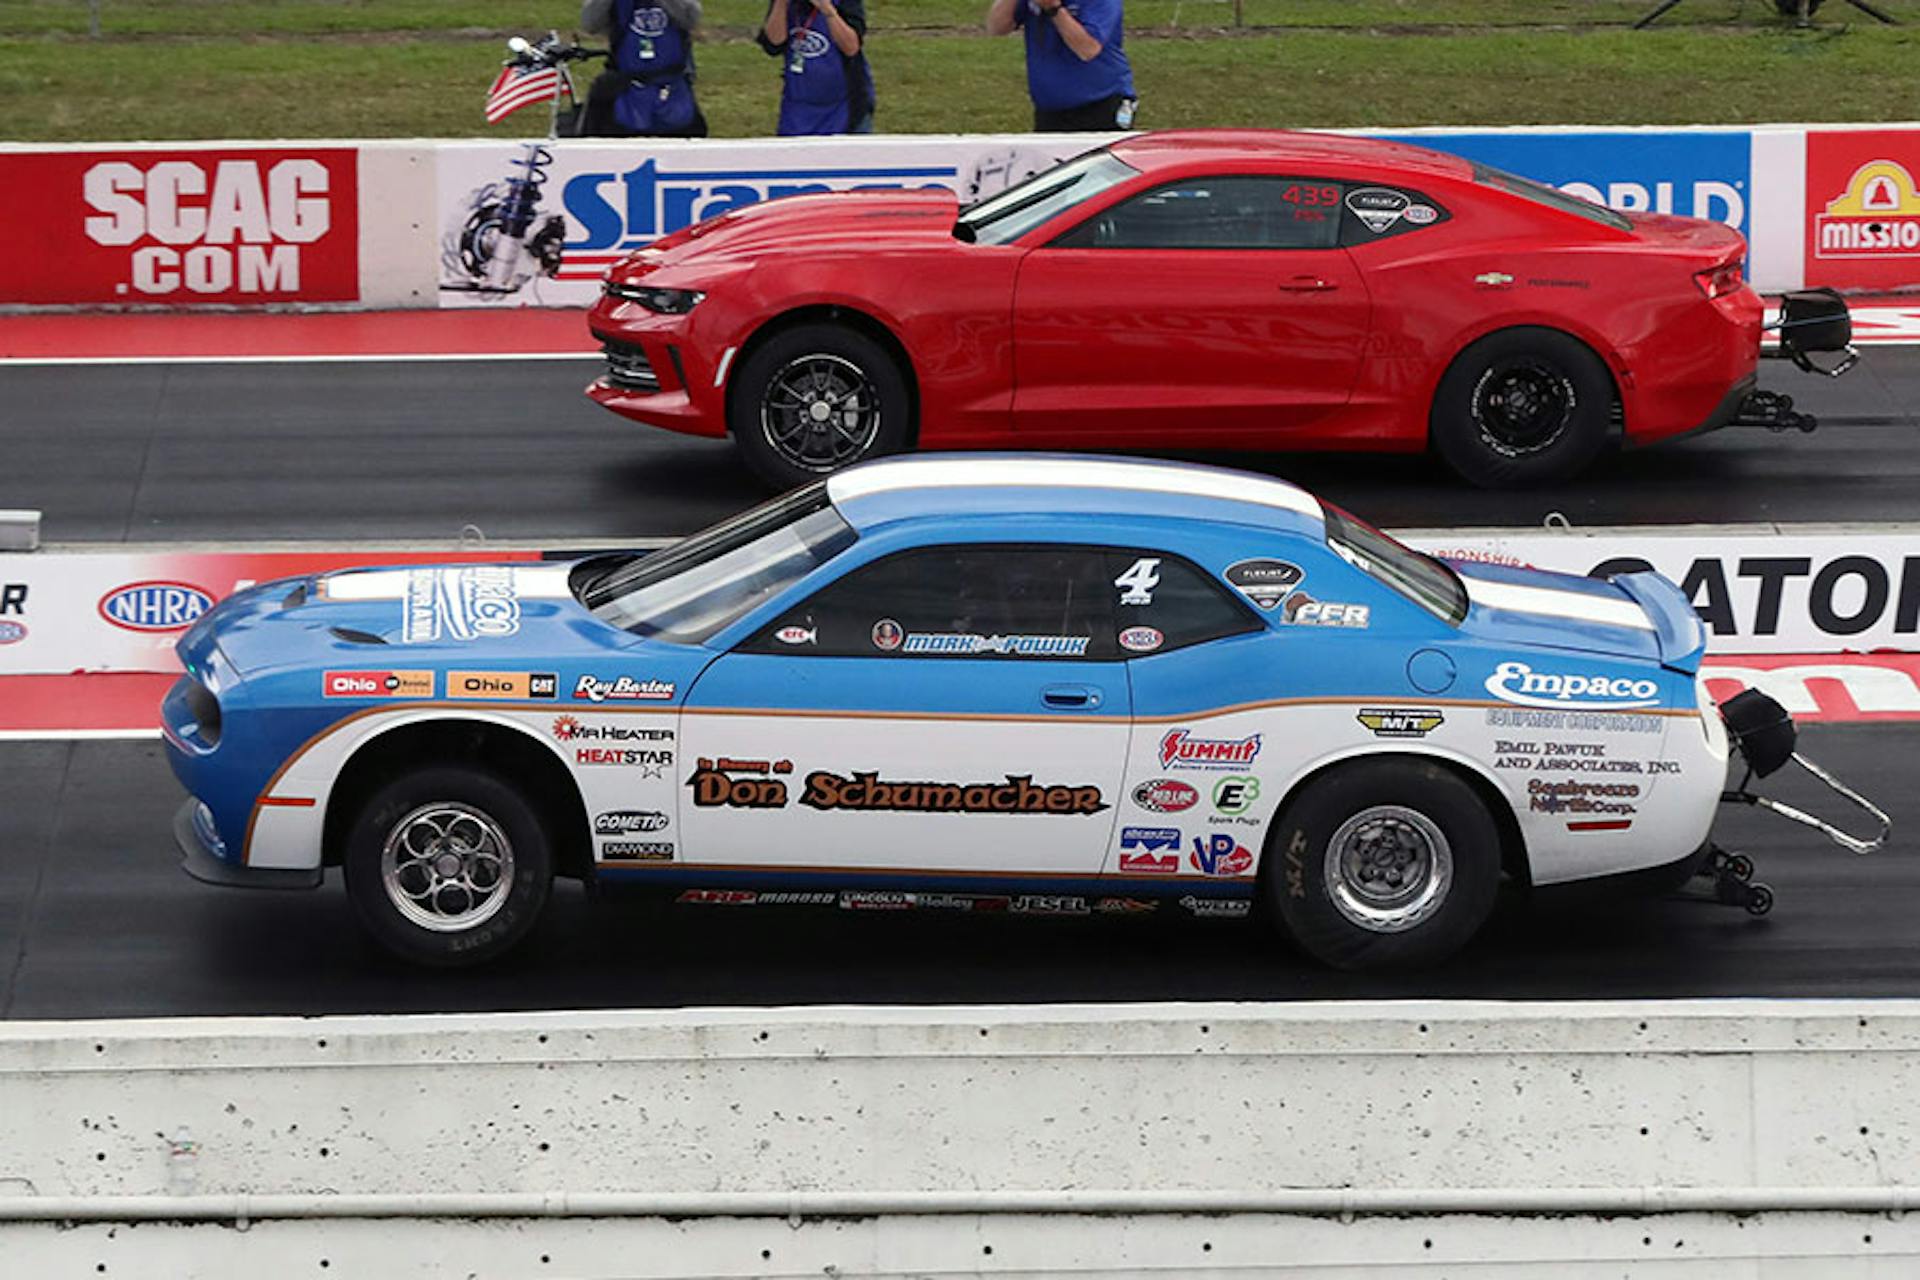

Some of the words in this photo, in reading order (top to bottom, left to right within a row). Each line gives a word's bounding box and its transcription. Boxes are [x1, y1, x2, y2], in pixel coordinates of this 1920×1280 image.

[83, 159, 331, 246] SCAG
[562, 158, 953, 251] Stra
[1282, 185, 1340, 206] 439
[116, 245, 300, 294] .COM
[1114, 558, 1160, 598] 4
[115, 586, 204, 625] NHRA
[1587, 556, 1920, 636] ATO
[332, 678, 377, 692] Ohio
[464, 679, 513, 692] Ohio
[531, 679, 554, 693] CAT
[1486, 662, 1660, 709] Empaco
[601, 727, 675, 741] HEATER
[1381, 716, 1424, 730] M/T
[576, 749, 674, 765] HEATSTAR
[1164, 733, 1254, 761] SUMMIT
[1495, 740, 1540, 754] EMIL
[1544, 742, 1605, 757] PAWUK
[1494, 758, 1532, 770] AND
[1535, 758, 1643, 774] ASSOCIATES,
[1647, 762, 1681, 774] INC.
[687, 770, 789, 808] Don
[799, 771, 1111, 814] Schumacher
[596, 815, 667, 829] COMETIC
[1193, 834, 1235, 874] VP
